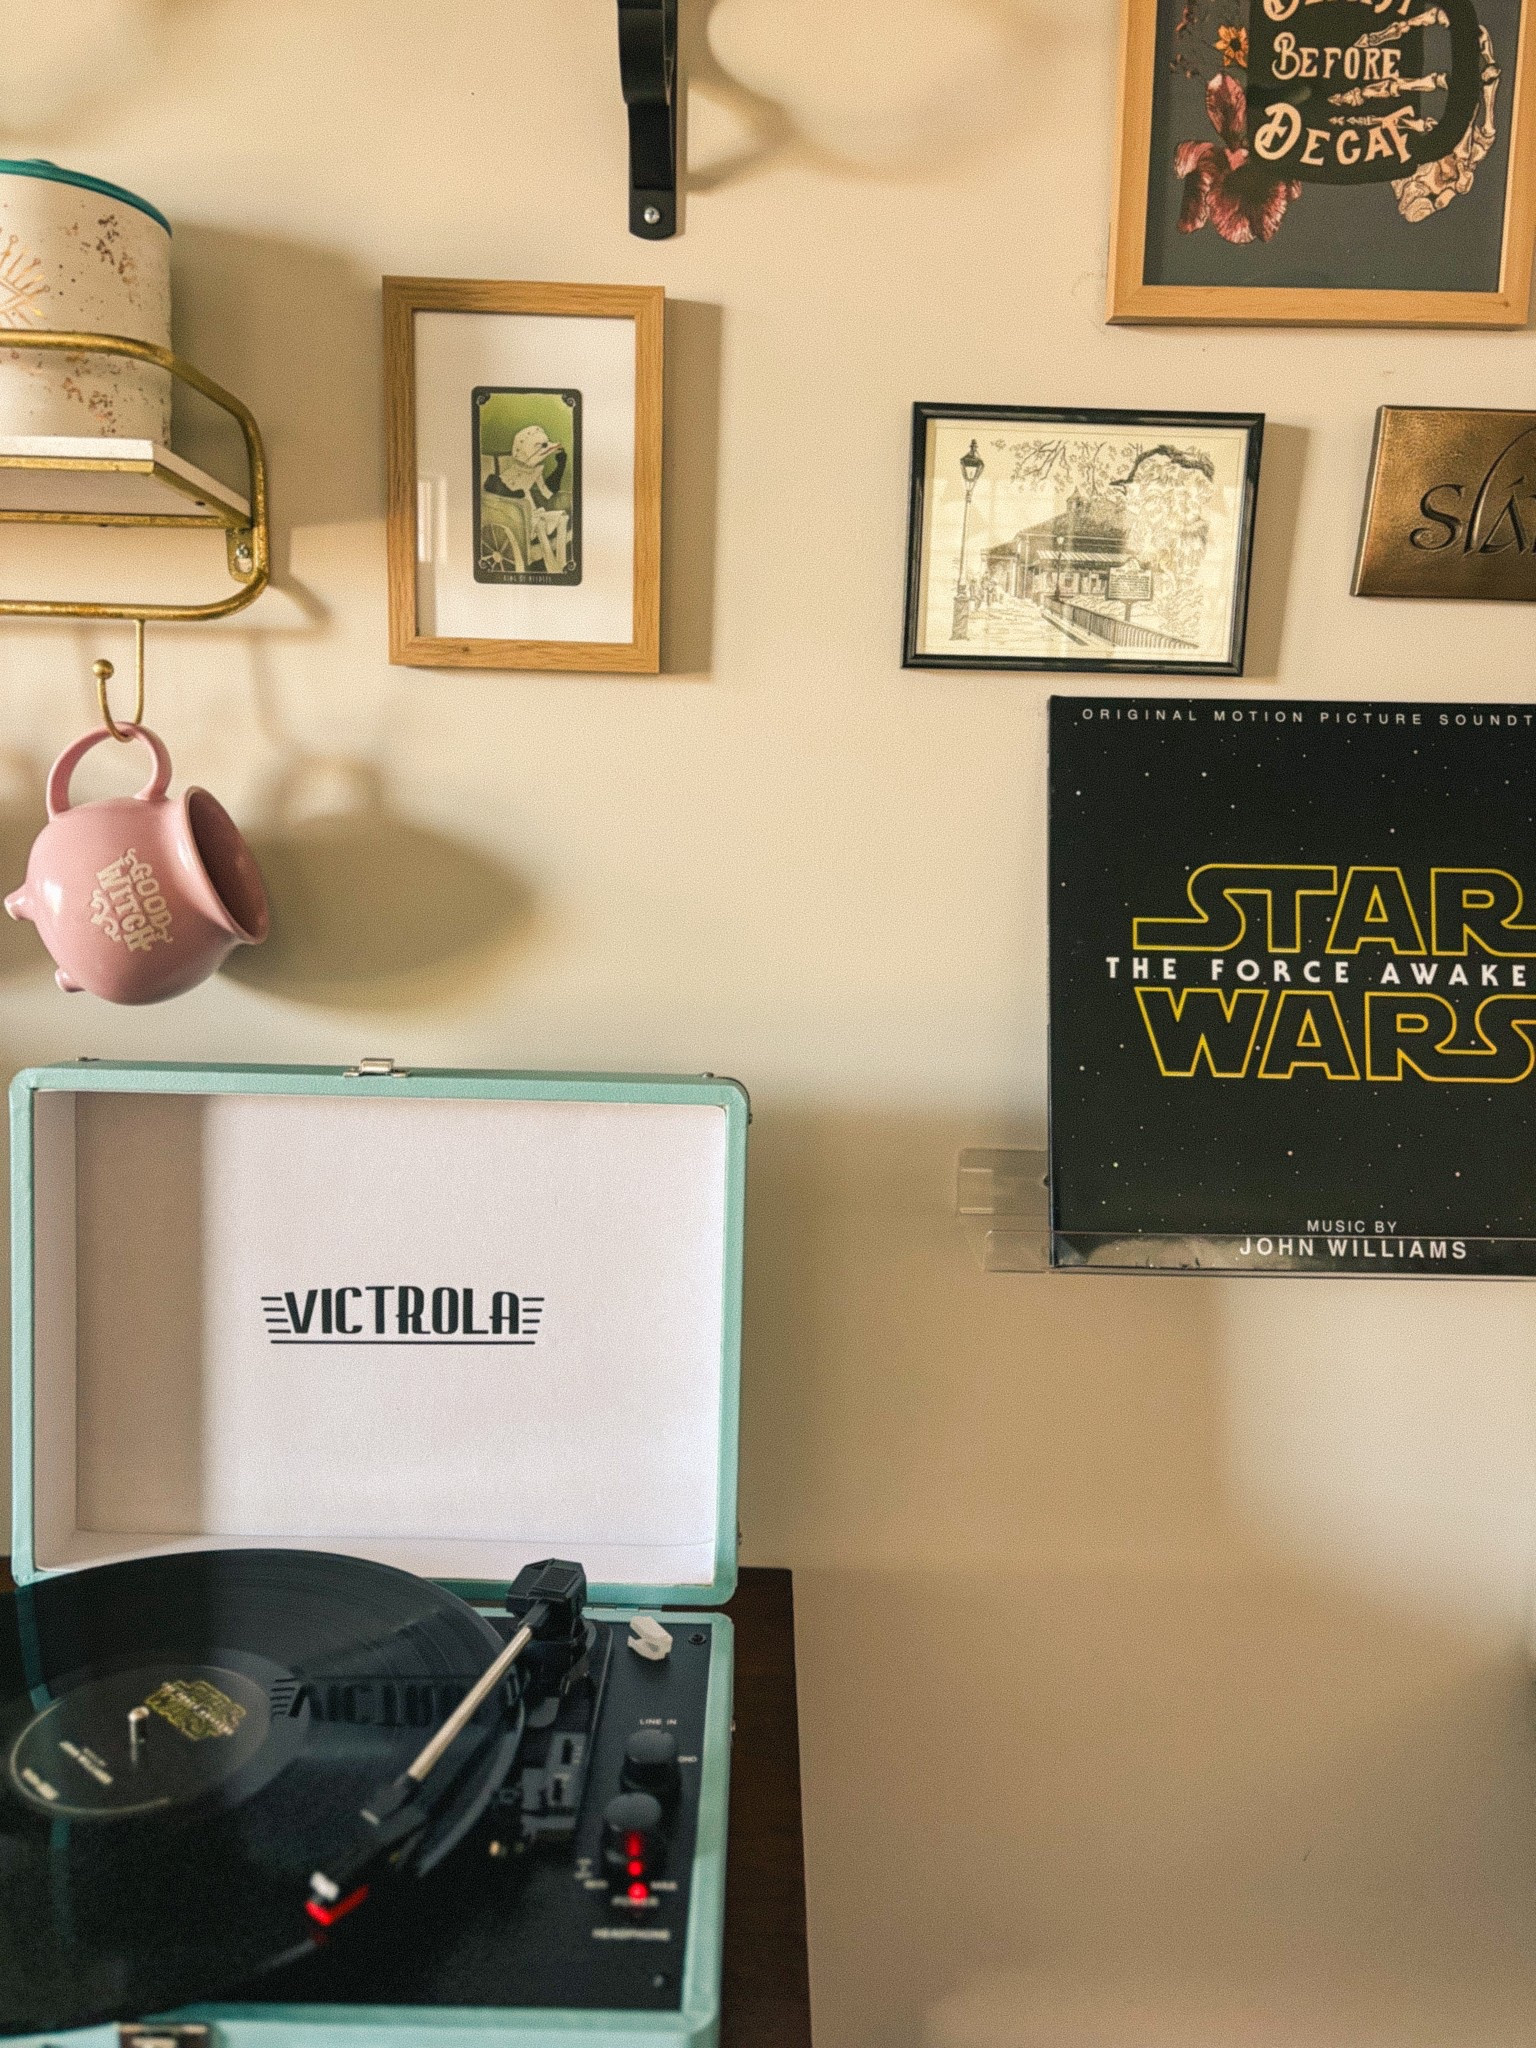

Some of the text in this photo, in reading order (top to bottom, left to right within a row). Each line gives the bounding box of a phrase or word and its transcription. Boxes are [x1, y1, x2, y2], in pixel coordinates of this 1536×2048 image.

[1271, 31, 1402, 81] BEFORE
[1253, 102, 1416, 167] DECAF
[1082, 708, 1534, 727] ORIGINAL MOTION PICTURE SOUNDT
[95, 858, 156, 953] WITCH
[130, 862, 173, 933] GOOD
[1131, 862, 1536, 958] STAR
[1106, 956, 1528, 988] THE FORCE AWAKE
[1133, 986, 1536, 1084] WARS
[1239, 1237, 1468, 1260] JOHN WILLIAMS
[1307, 1220, 1398, 1234] MUSIC BY
[283, 1285, 520, 1335] VICTROLA
[639, 1718, 678, 1726] LINE IN
